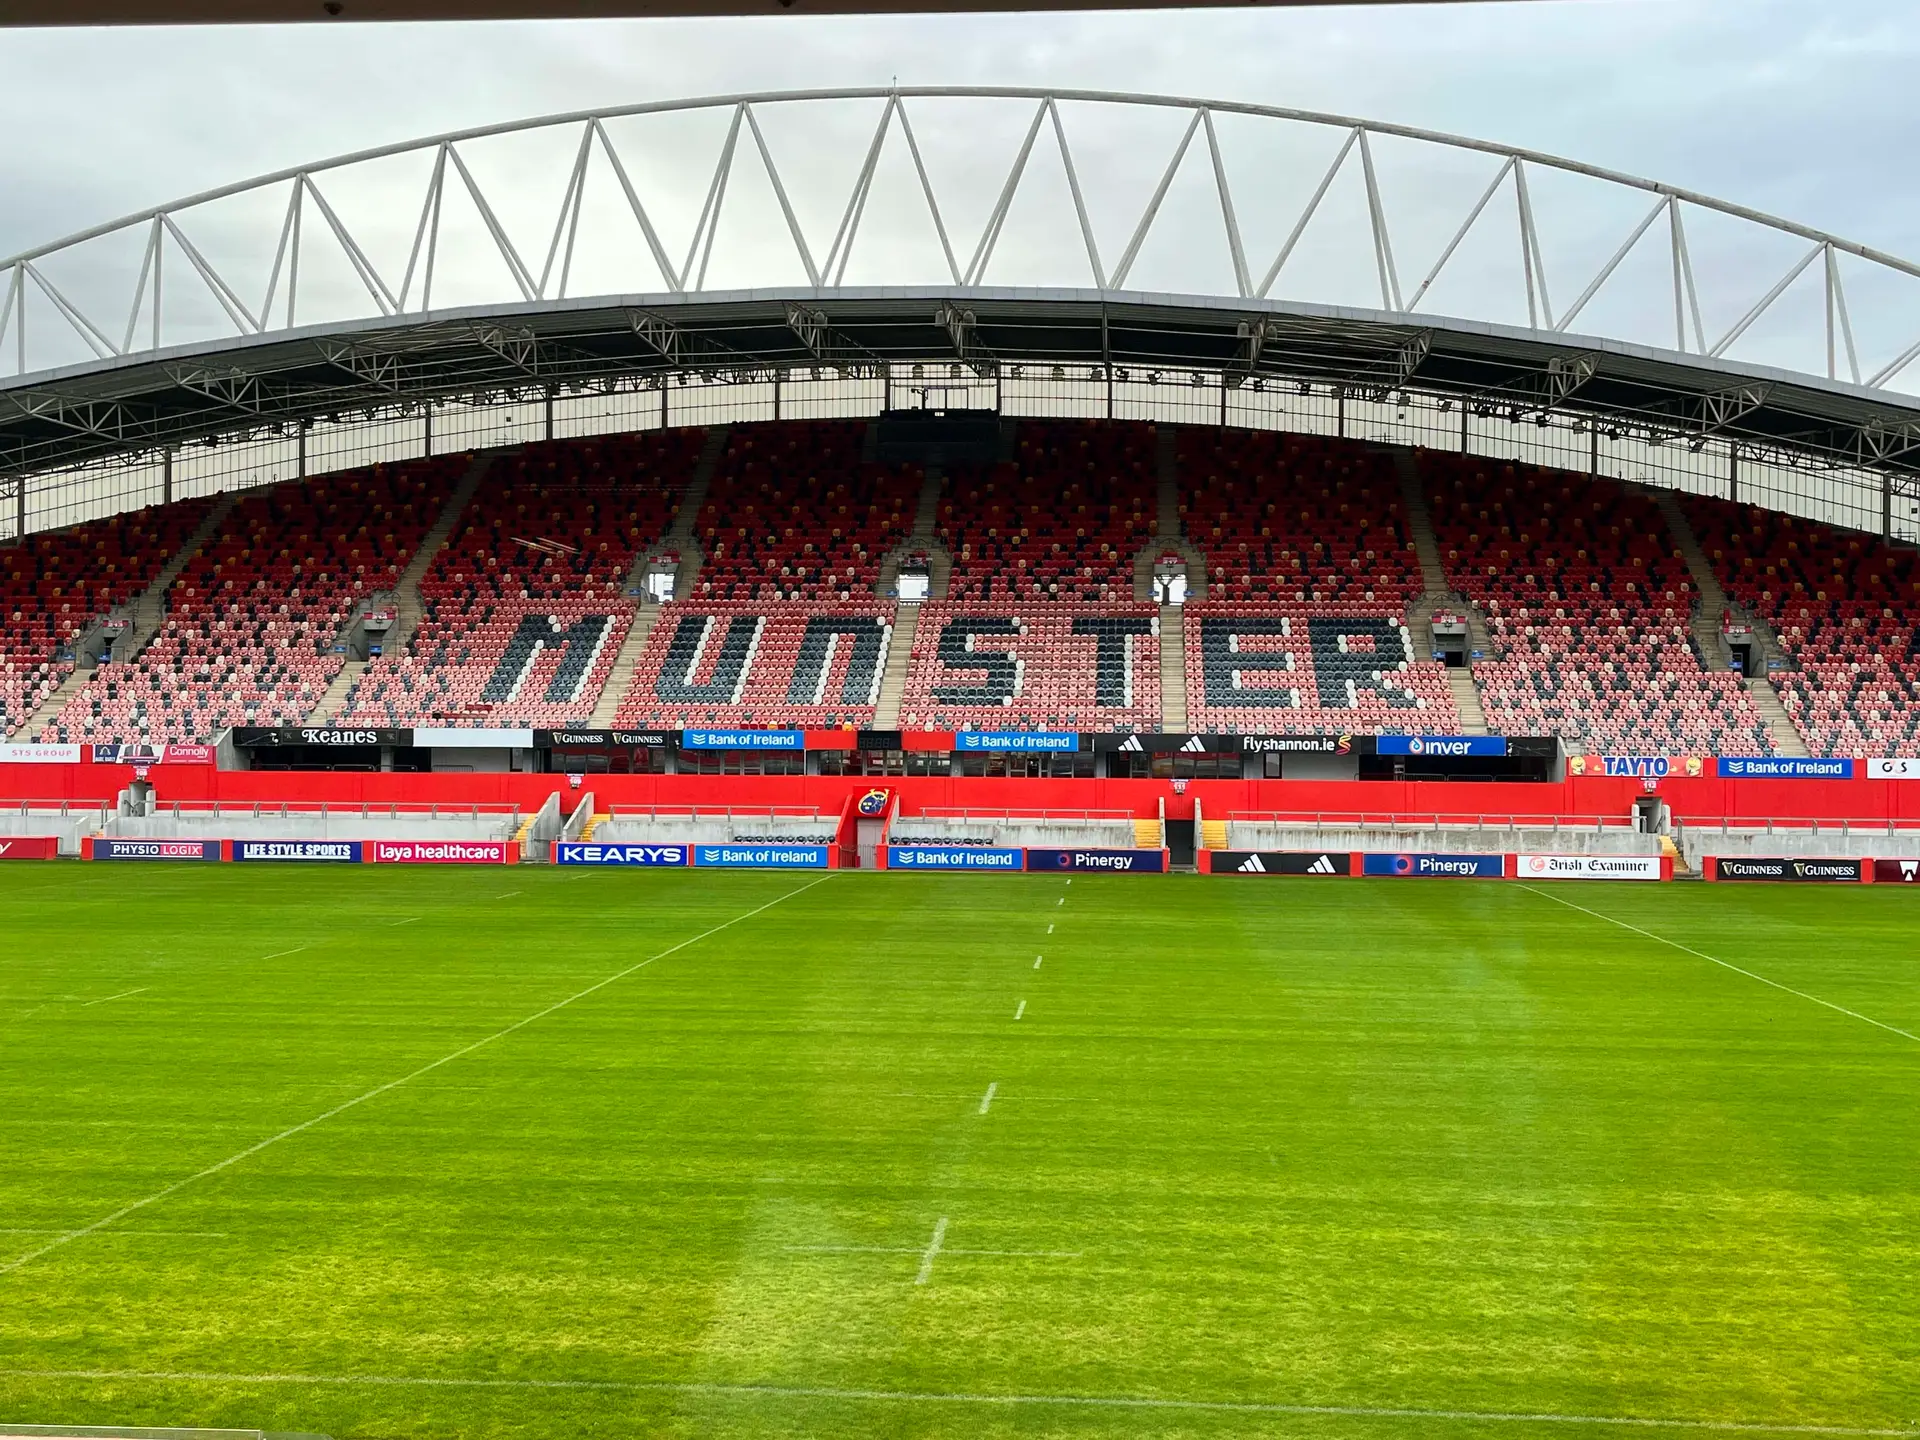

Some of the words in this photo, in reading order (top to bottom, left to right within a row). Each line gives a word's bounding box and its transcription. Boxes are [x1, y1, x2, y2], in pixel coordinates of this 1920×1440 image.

[481, 614, 1425, 708] MUNSTER
[302, 729, 377, 744] Keanes
[562, 733, 604, 744] GUINNESS
[622, 734, 663, 745] GUINNESS
[708, 734, 737, 745] Bank
[738, 734, 752, 745] of
[753, 734, 795, 745] Ireland
[982, 736, 1011, 747] Bank
[1012, 736, 1026, 747] of
[1027, 736, 1069, 747] Ireland
[1243, 737, 1335, 753] flyshannon.ie
[1425, 741, 1471, 755] inver
[12, 749, 33, 757] STS
[36, 749, 72, 757] GROUP
[170, 746, 208, 758] Connolly
[1603, 756, 1670, 777] TAYTO
[1746, 762, 1777, 773] Bank
[1779, 762, 1794, 773] of
[1796, 762, 1842, 774] Ireland
[113, 845, 159, 854] PHYSIO
[163, 845, 201, 855] LOGIX
[243, 844, 268, 856] LIFE
[269, 844, 304, 856] STYLE
[306, 844, 351, 856] SPORTS
[380, 845, 413, 861] laya
[415, 845, 499, 859] healthcare
[564, 847, 682, 862] KEARYS
[722, 850, 754, 862] Bank
[755, 850, 769, 862] of
[771, 850, 817, 863] Ireland
[916, 851, 949, 864] Bank
[950, 851, 965, 864] of
[966, 852, 1012, 865] Ireland
[1075, 854, 1132, 869] Pinergy
[1420, 858, 1478, 874] Pinergy
[1549, 858, 1582, 871] Irish
[1588, 859, 1649, 872] Examiner
[1733, 864, 1783, 875] GUINNESS
[1805, 865, 1855, 876] GUINNESS
